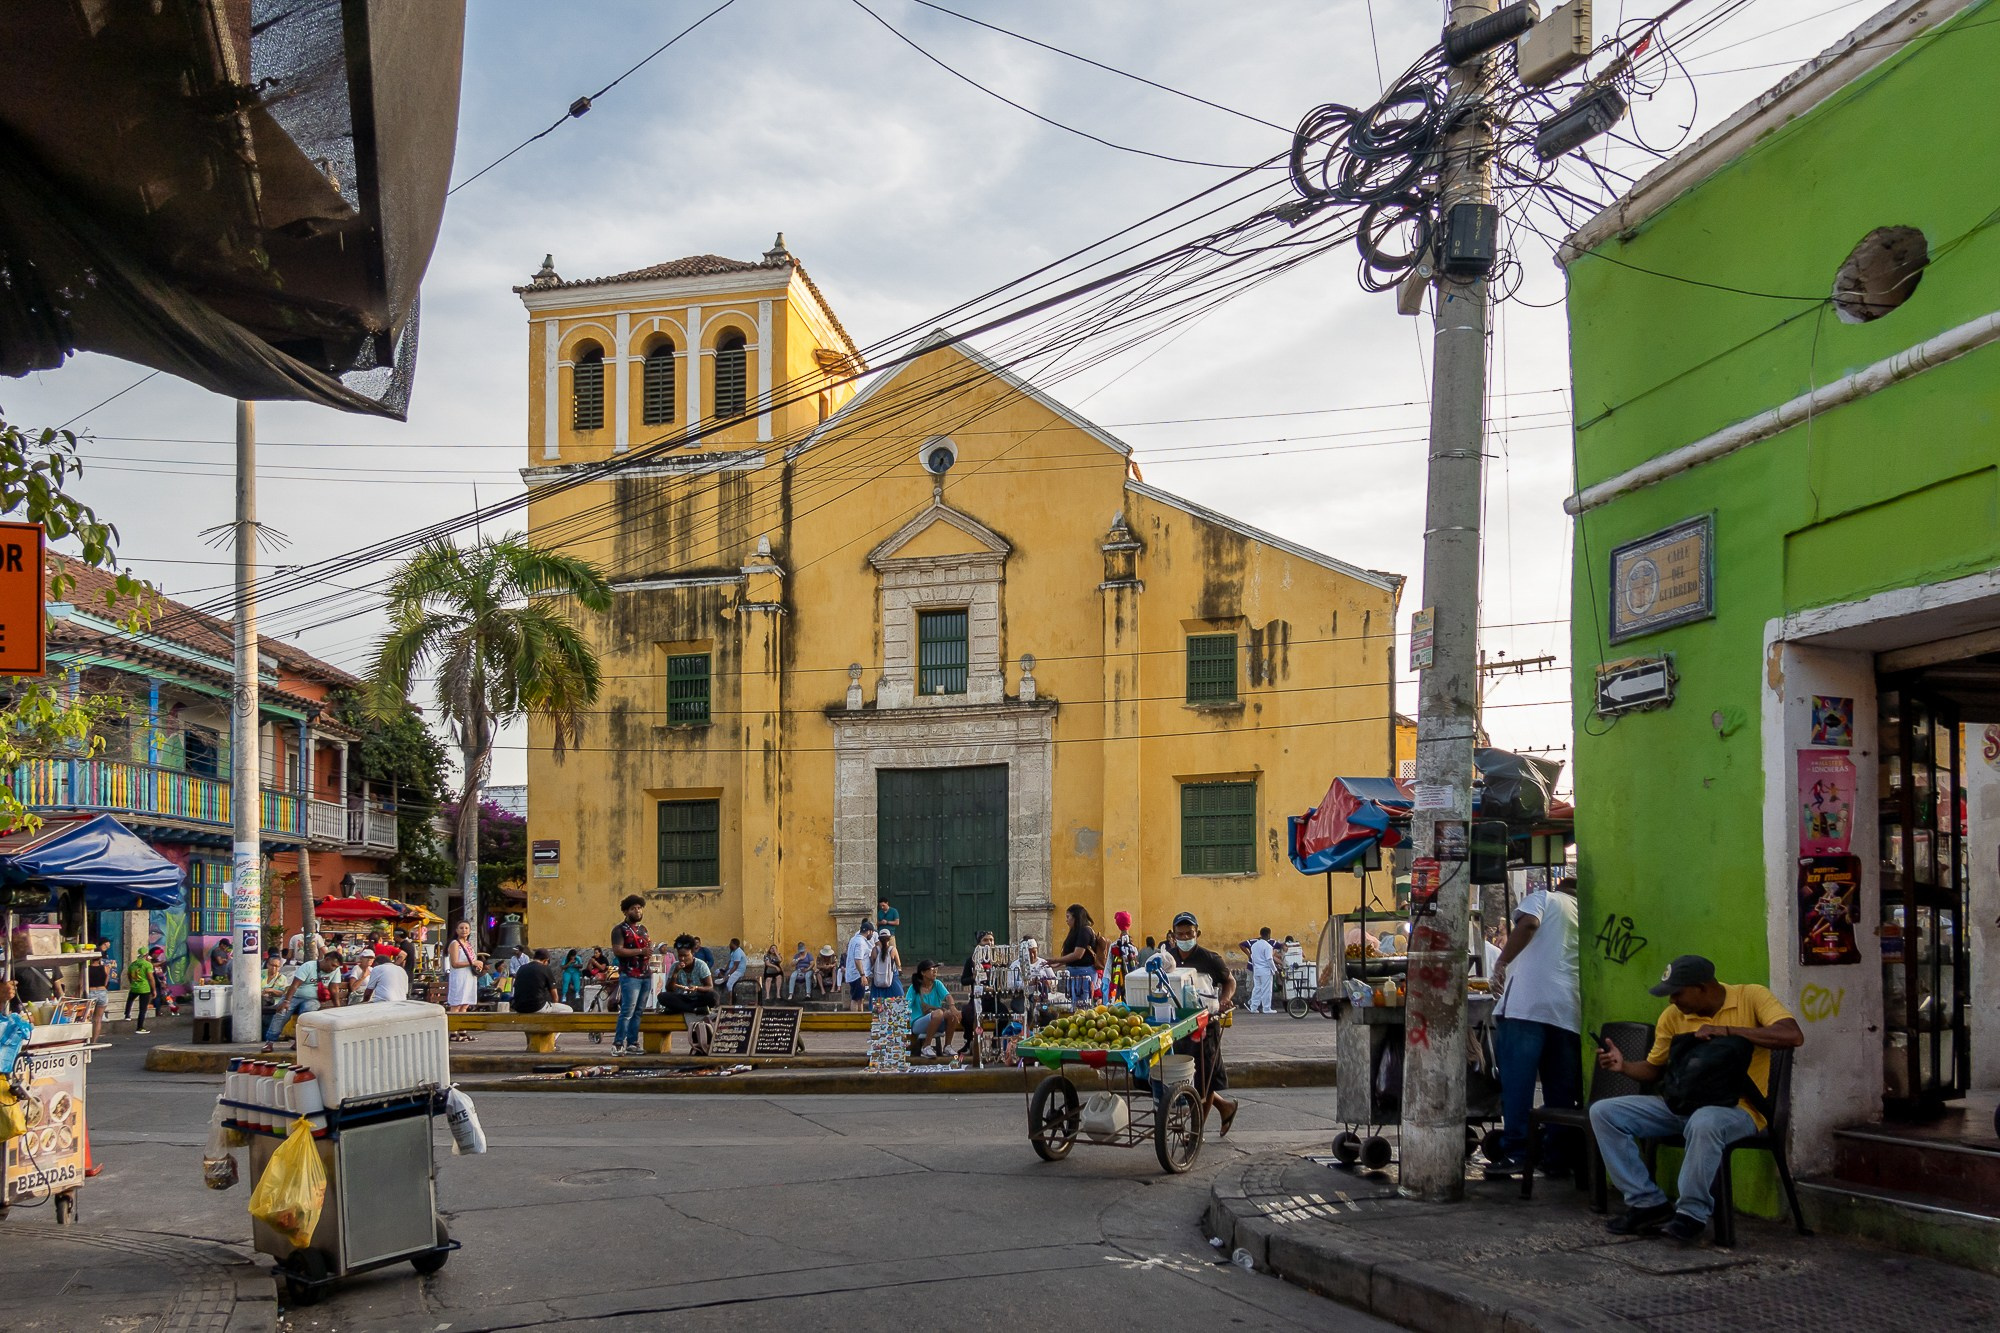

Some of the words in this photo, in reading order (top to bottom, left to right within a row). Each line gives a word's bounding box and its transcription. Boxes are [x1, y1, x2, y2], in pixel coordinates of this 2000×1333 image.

[0, 543, 23, 572] R
[1667, 545, 1689, 564] CALLE
[1671, 565, 1685, 581] DEL
[1659, 579, 1698, 602] GUERRERO
[18, 1164, 75, 1191] BEBIDAS
